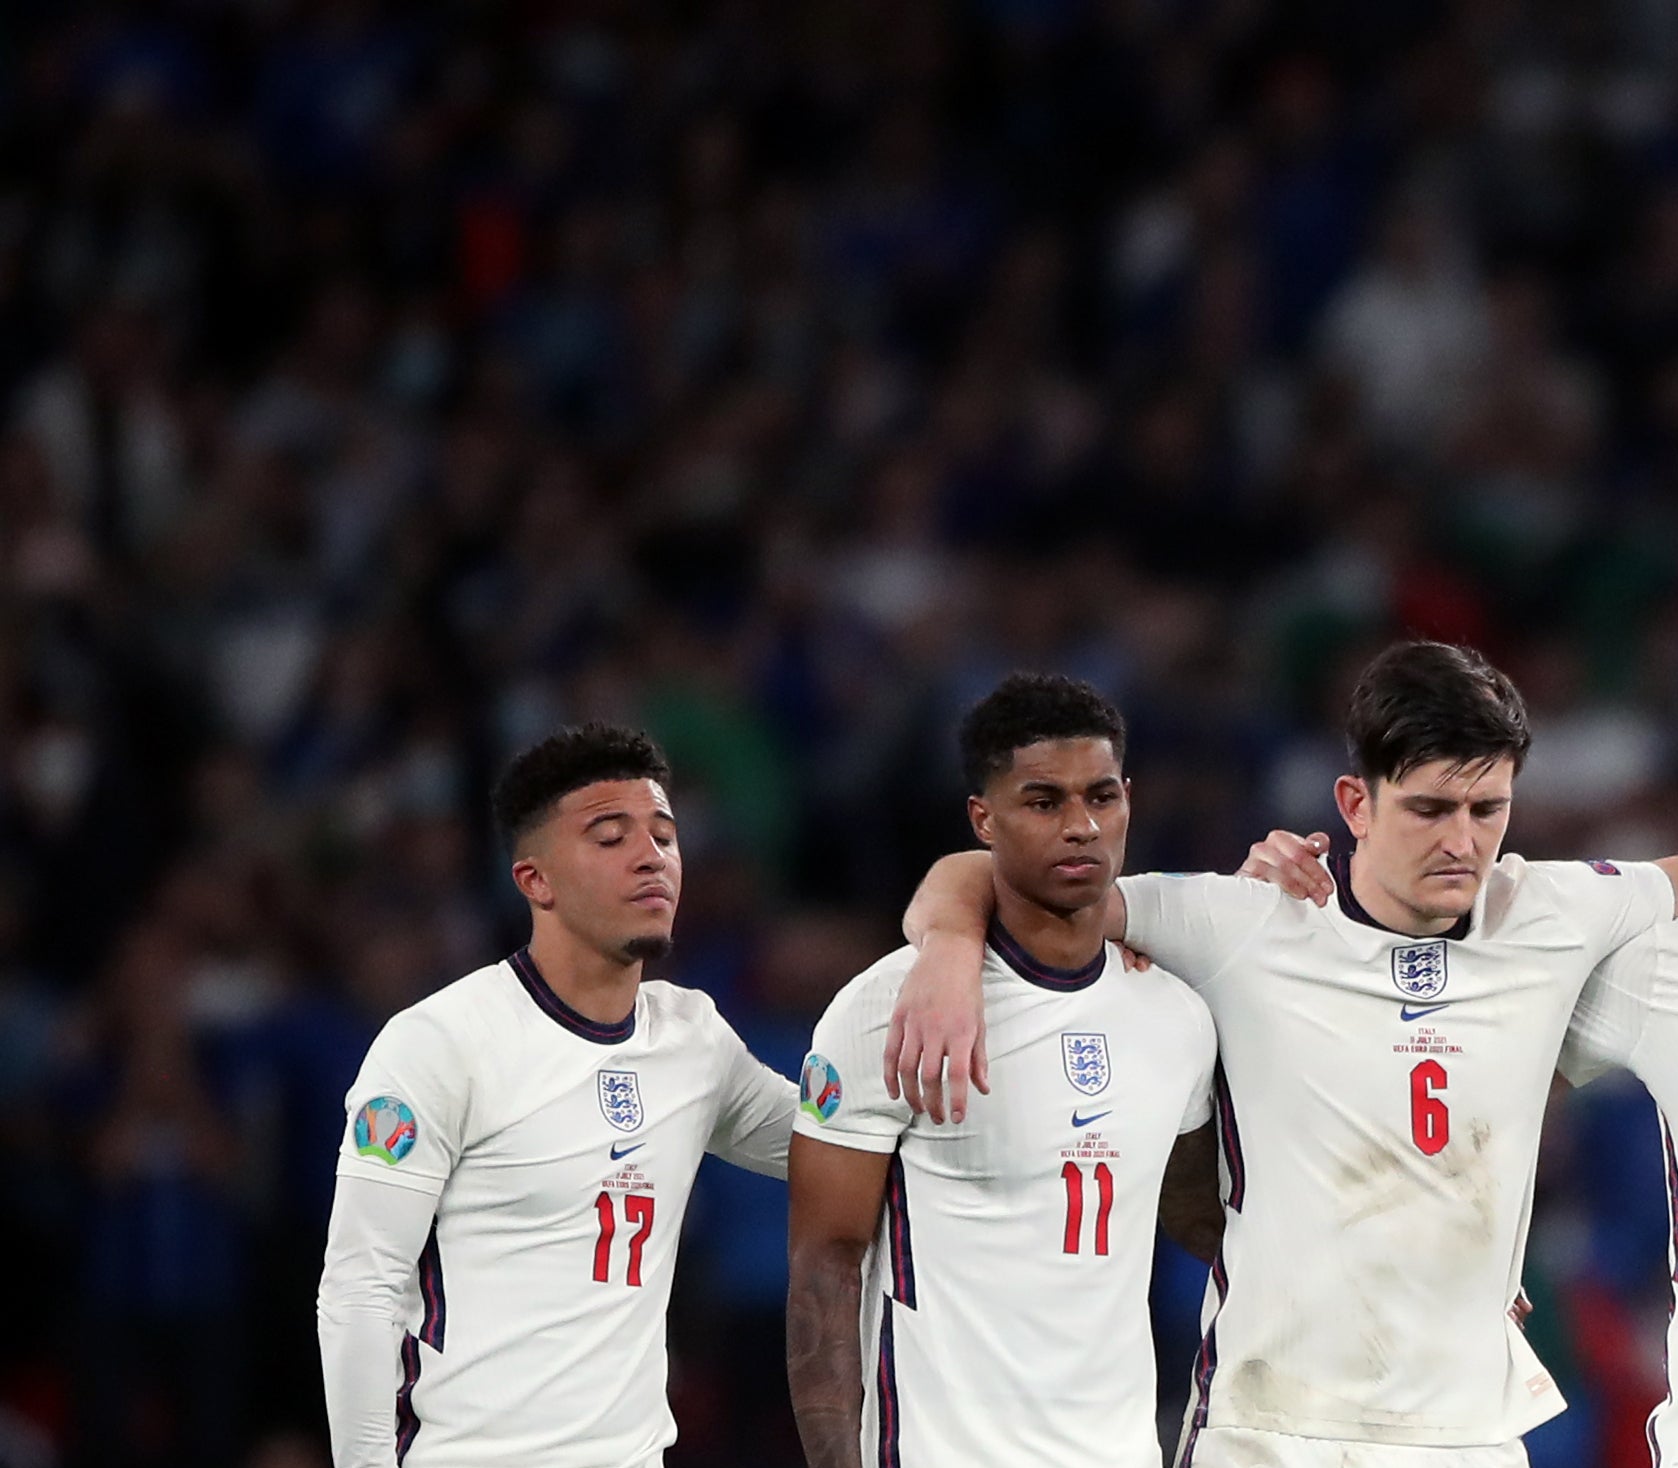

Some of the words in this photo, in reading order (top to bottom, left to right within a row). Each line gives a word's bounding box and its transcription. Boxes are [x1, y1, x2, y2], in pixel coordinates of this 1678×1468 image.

[1393, 1045, 1409, 1053] UEFA
[1444, 1045, 1463, 1053] FINAL
[1416, 1036, 1432, 1044] JULY
[1409, 1057, 1451, 1158] 6
[592, 1191, 656, 1289] 17
[1061, 1160, 1115, 1257] 11
